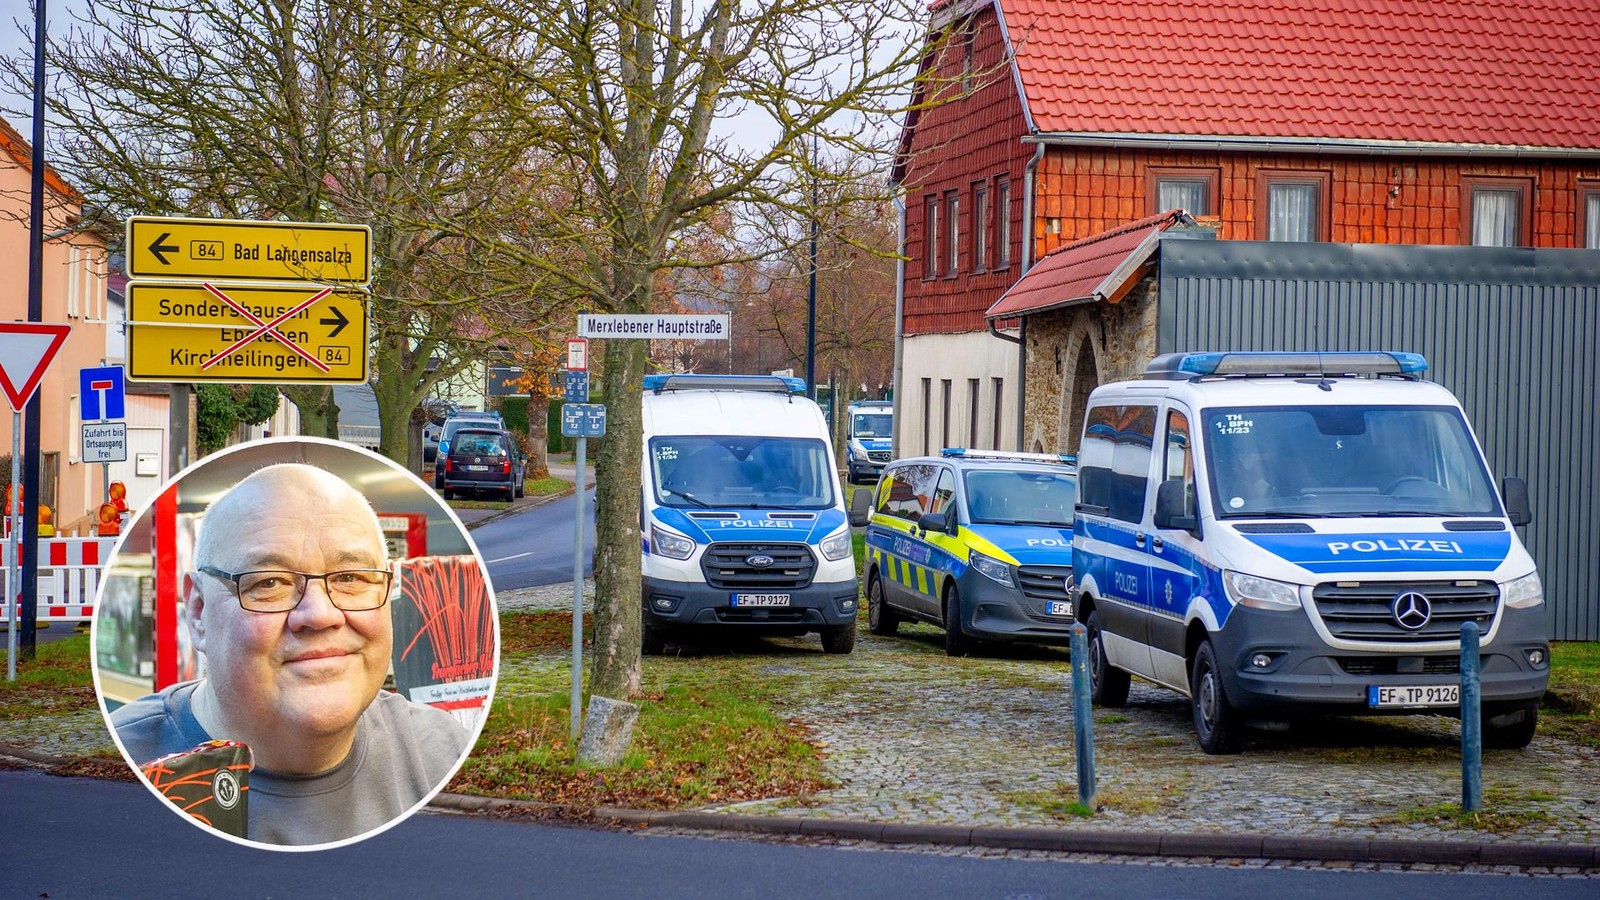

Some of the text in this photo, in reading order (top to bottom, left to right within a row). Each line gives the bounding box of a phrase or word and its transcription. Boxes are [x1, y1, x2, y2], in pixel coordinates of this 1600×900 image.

[198, 243, 352, 266] 84 Bad Langensalza
[587, 318, 722, 336] Merxlebener Hauptstraße
[325, 349, 342, 362] 84
[84, 428, 124, 438] Zufahrt bis
[86, 439, 123, 449] Ortsausgang
[98, 450, 111, 459] frei
[720, 520, 794, 528] POLIZEI
[1026, 539, 1073, 547] POL
[1327, 539, 1463, 555] POLIZEI
[1114, 572, 1138, 595] POLIZEI
[737, 596, 789, 605] EF TP 9127
[1053, 604, 1063, 613] EF
[1380, 688, 1458, 703] EF TP 9126
